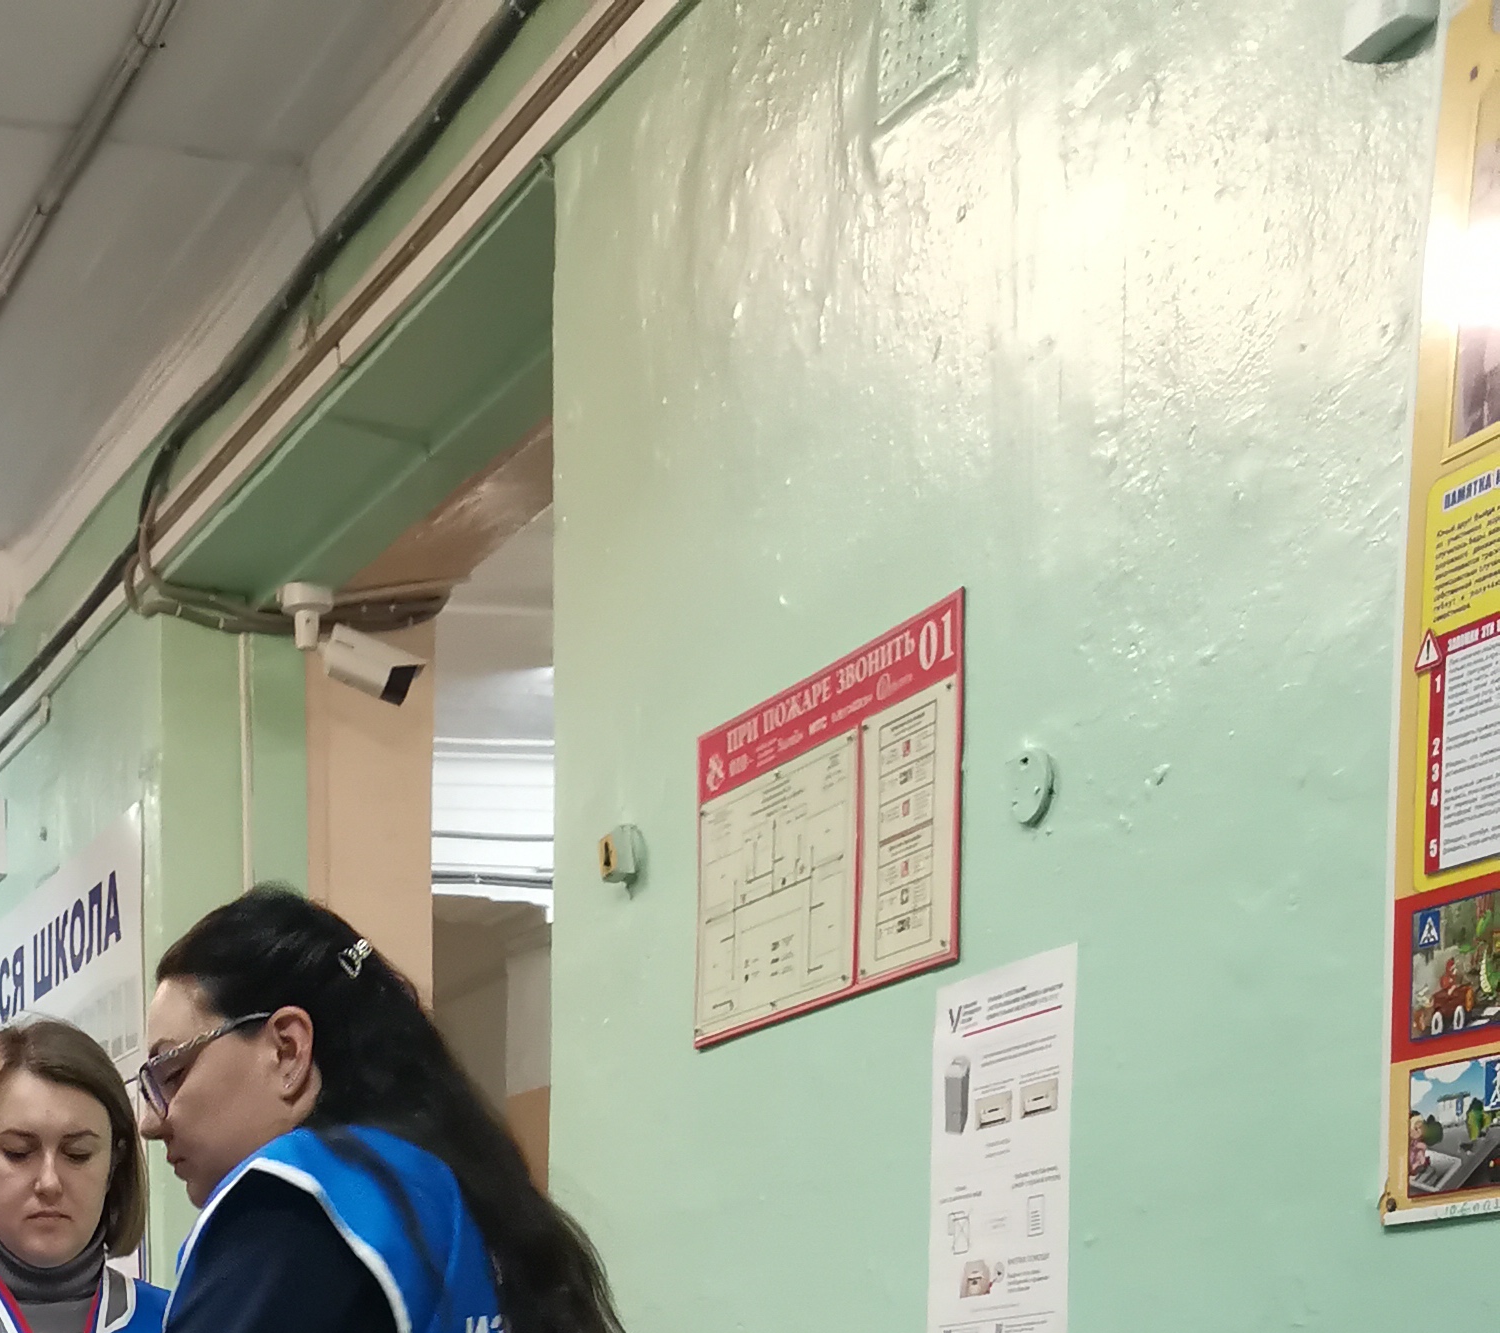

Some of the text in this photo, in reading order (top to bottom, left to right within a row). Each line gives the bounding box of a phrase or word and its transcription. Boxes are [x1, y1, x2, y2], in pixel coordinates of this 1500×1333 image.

[1443, 473, 1492, 510] ПАМЯТКА
[726, 714, 759, 754] ПРИ
[762, 676, 832, 735] ПОЖАРЕ
[836, 630, 916, 694] ЗВОНИТЬ
[918, 608, 955, 671] 01
[1434, 674, 1442, 693] 1
[1431, 737, 1440, 757] 2
[1431, 763, 1440, 782] 3
[1430, 788, 1439, 807] 4
[1429, 838, 1438, 857] 5
[33, 870, 122, 1003] ШКОЛА
